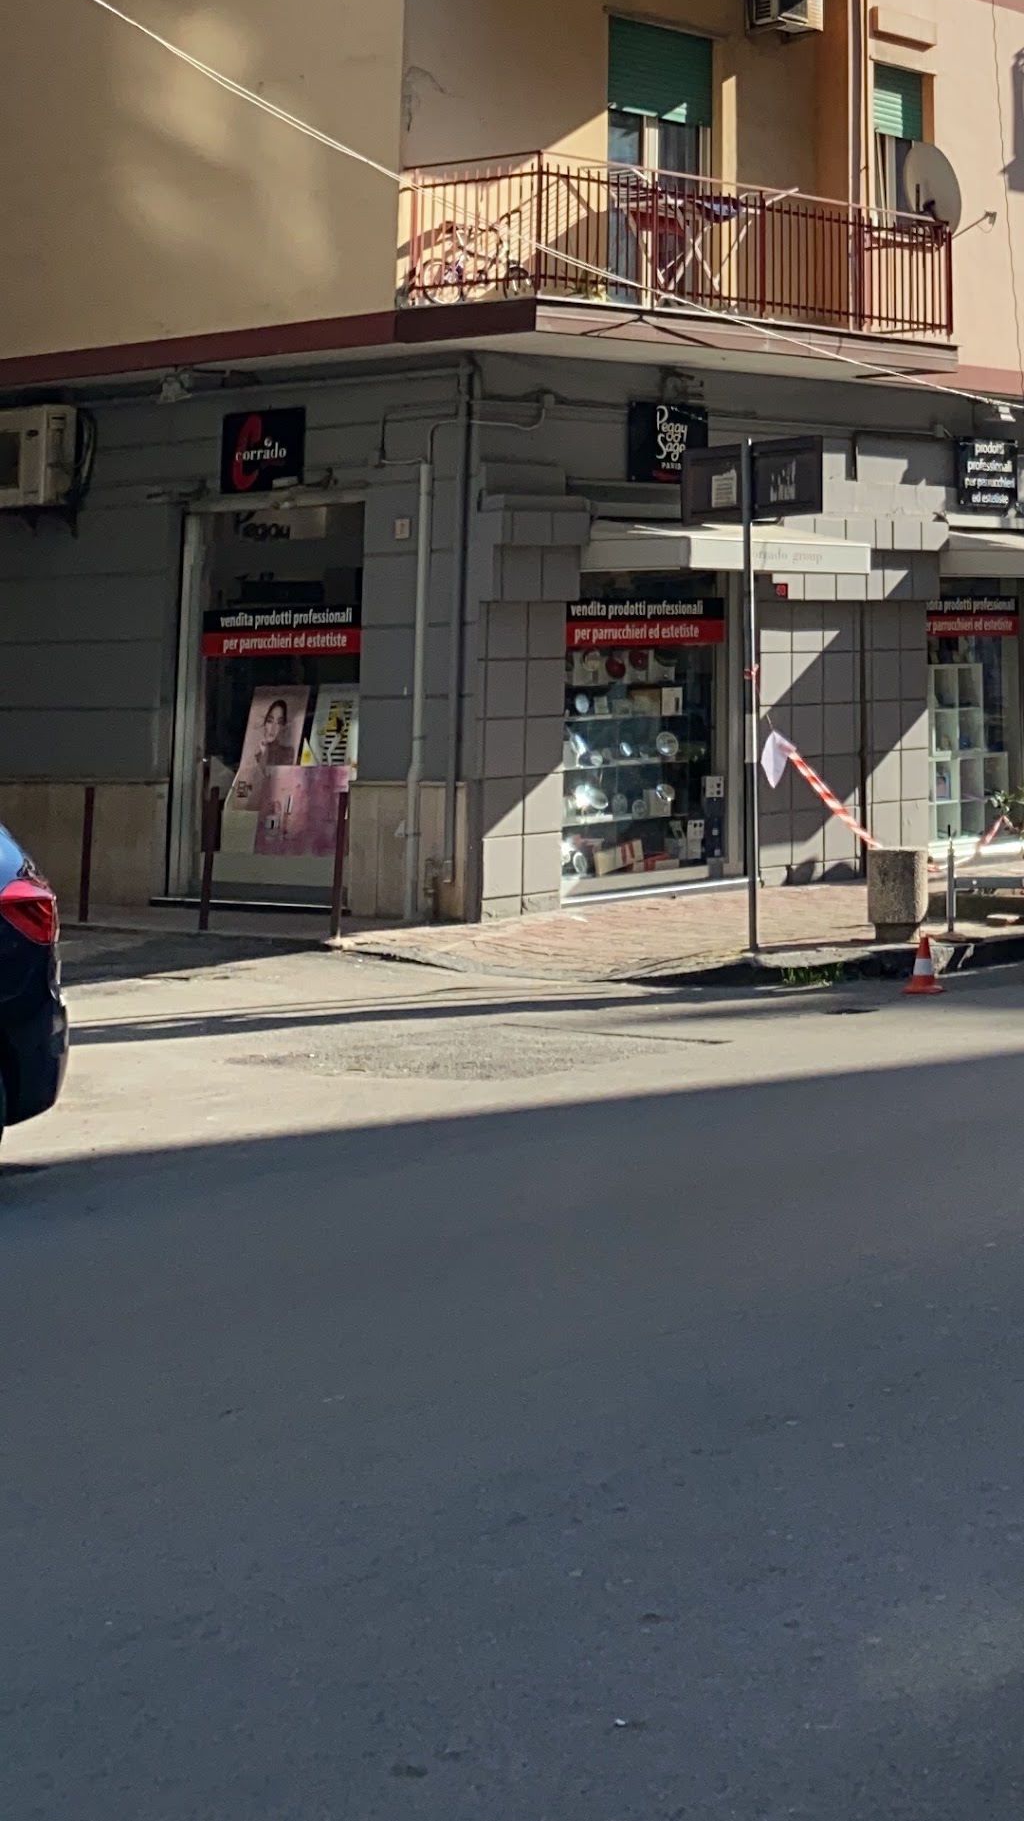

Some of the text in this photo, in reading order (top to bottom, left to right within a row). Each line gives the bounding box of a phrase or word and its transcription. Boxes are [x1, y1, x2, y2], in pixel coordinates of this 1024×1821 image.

[656, 405, 688, 443] Peggy
[974, 441, 1005, 456] prodotti
[571, 600, 704, 619] vendita prodotti professionali
[944, 597, 972, 613] prodotti
[220, 607, 352, 630] vendita prodotti professionali
[974, 617, 983, 631] ed
[223, 632, 347, 653] per parrucchieri ed estetiste
[574, 623, 700, 644] per parrucchieri ed estetiste
